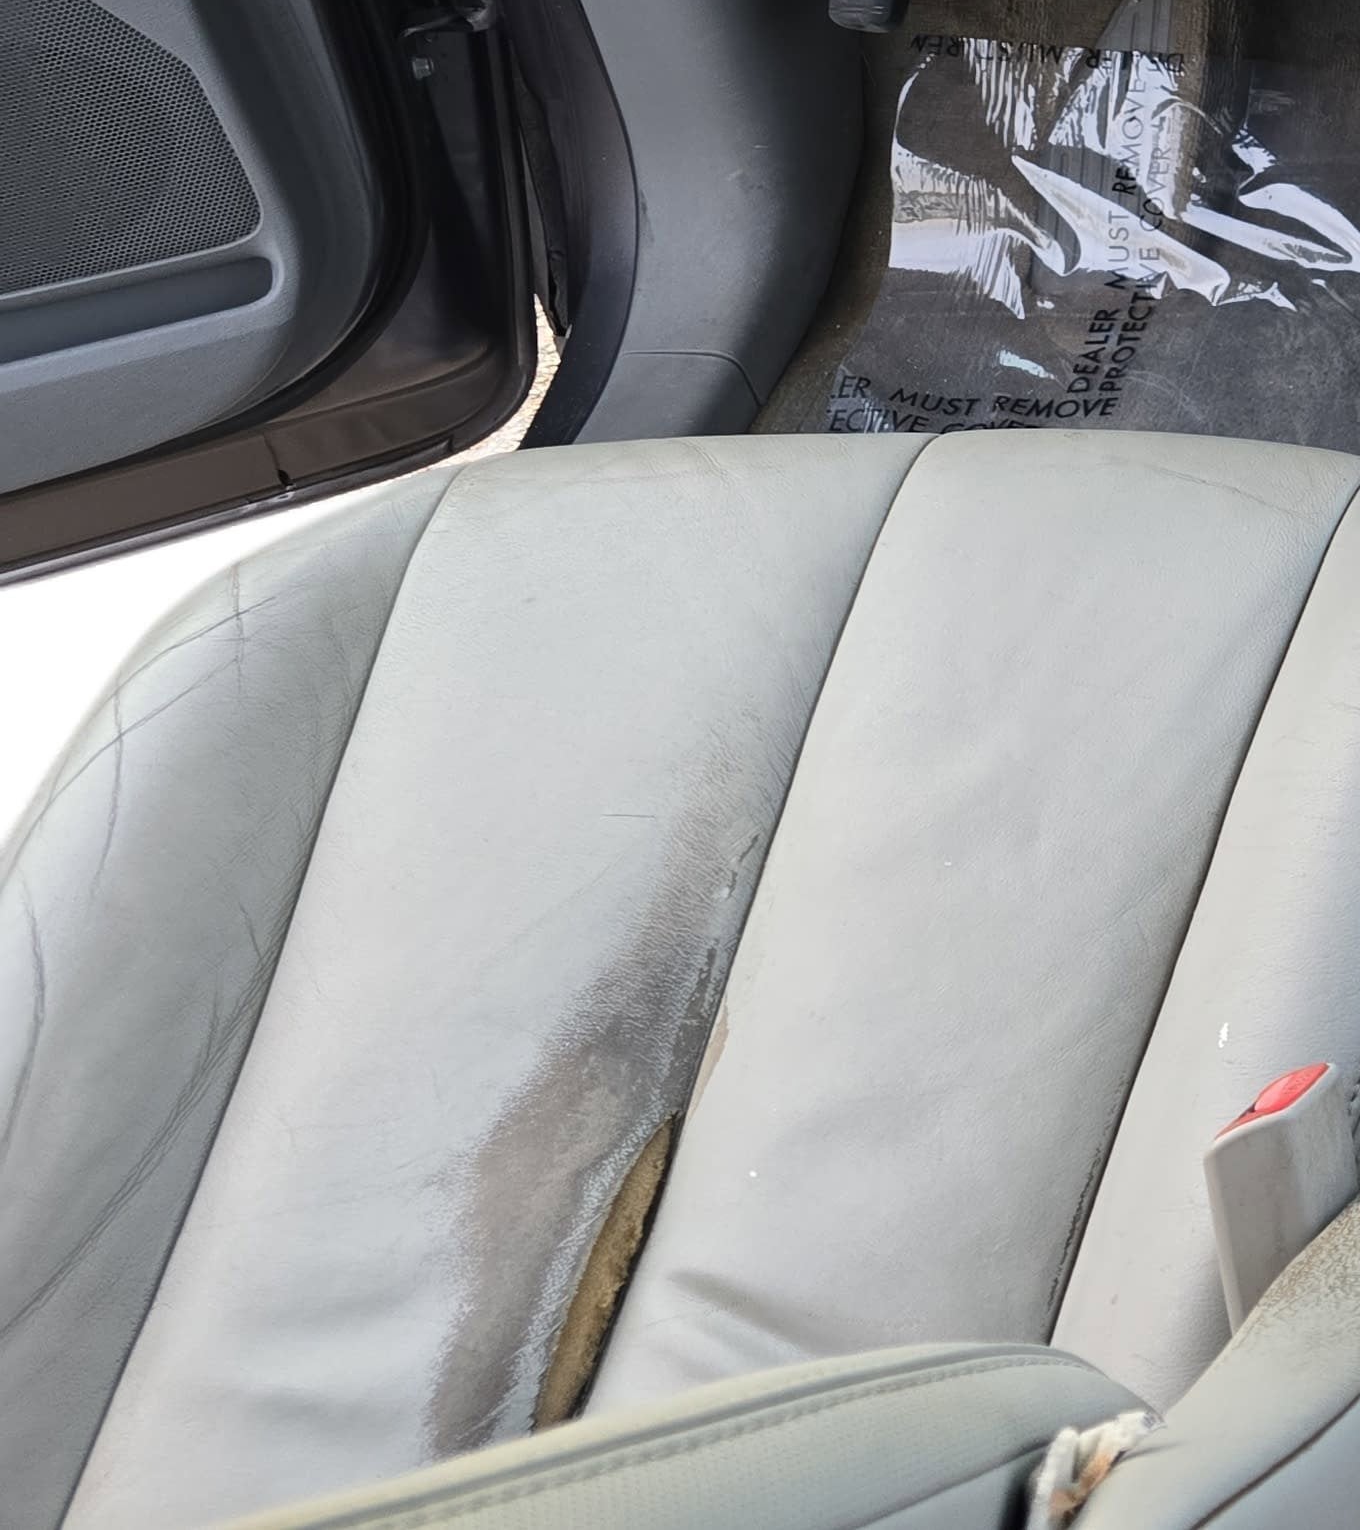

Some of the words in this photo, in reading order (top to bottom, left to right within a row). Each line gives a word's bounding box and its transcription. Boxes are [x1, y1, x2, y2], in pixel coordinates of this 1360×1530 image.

[1112, 76, 1147, 196] REMOVE
[1097, 247, 1162, 394] PROTECTIVE
[1139, 146, 1171, 233] COVER
[1104, 210, 1131, 289] MUST
[1067, 308, 1120, 394] DEALER
[888, 387, 982, 417] MUST
[992, 395, 1119, 419] REMOVE
